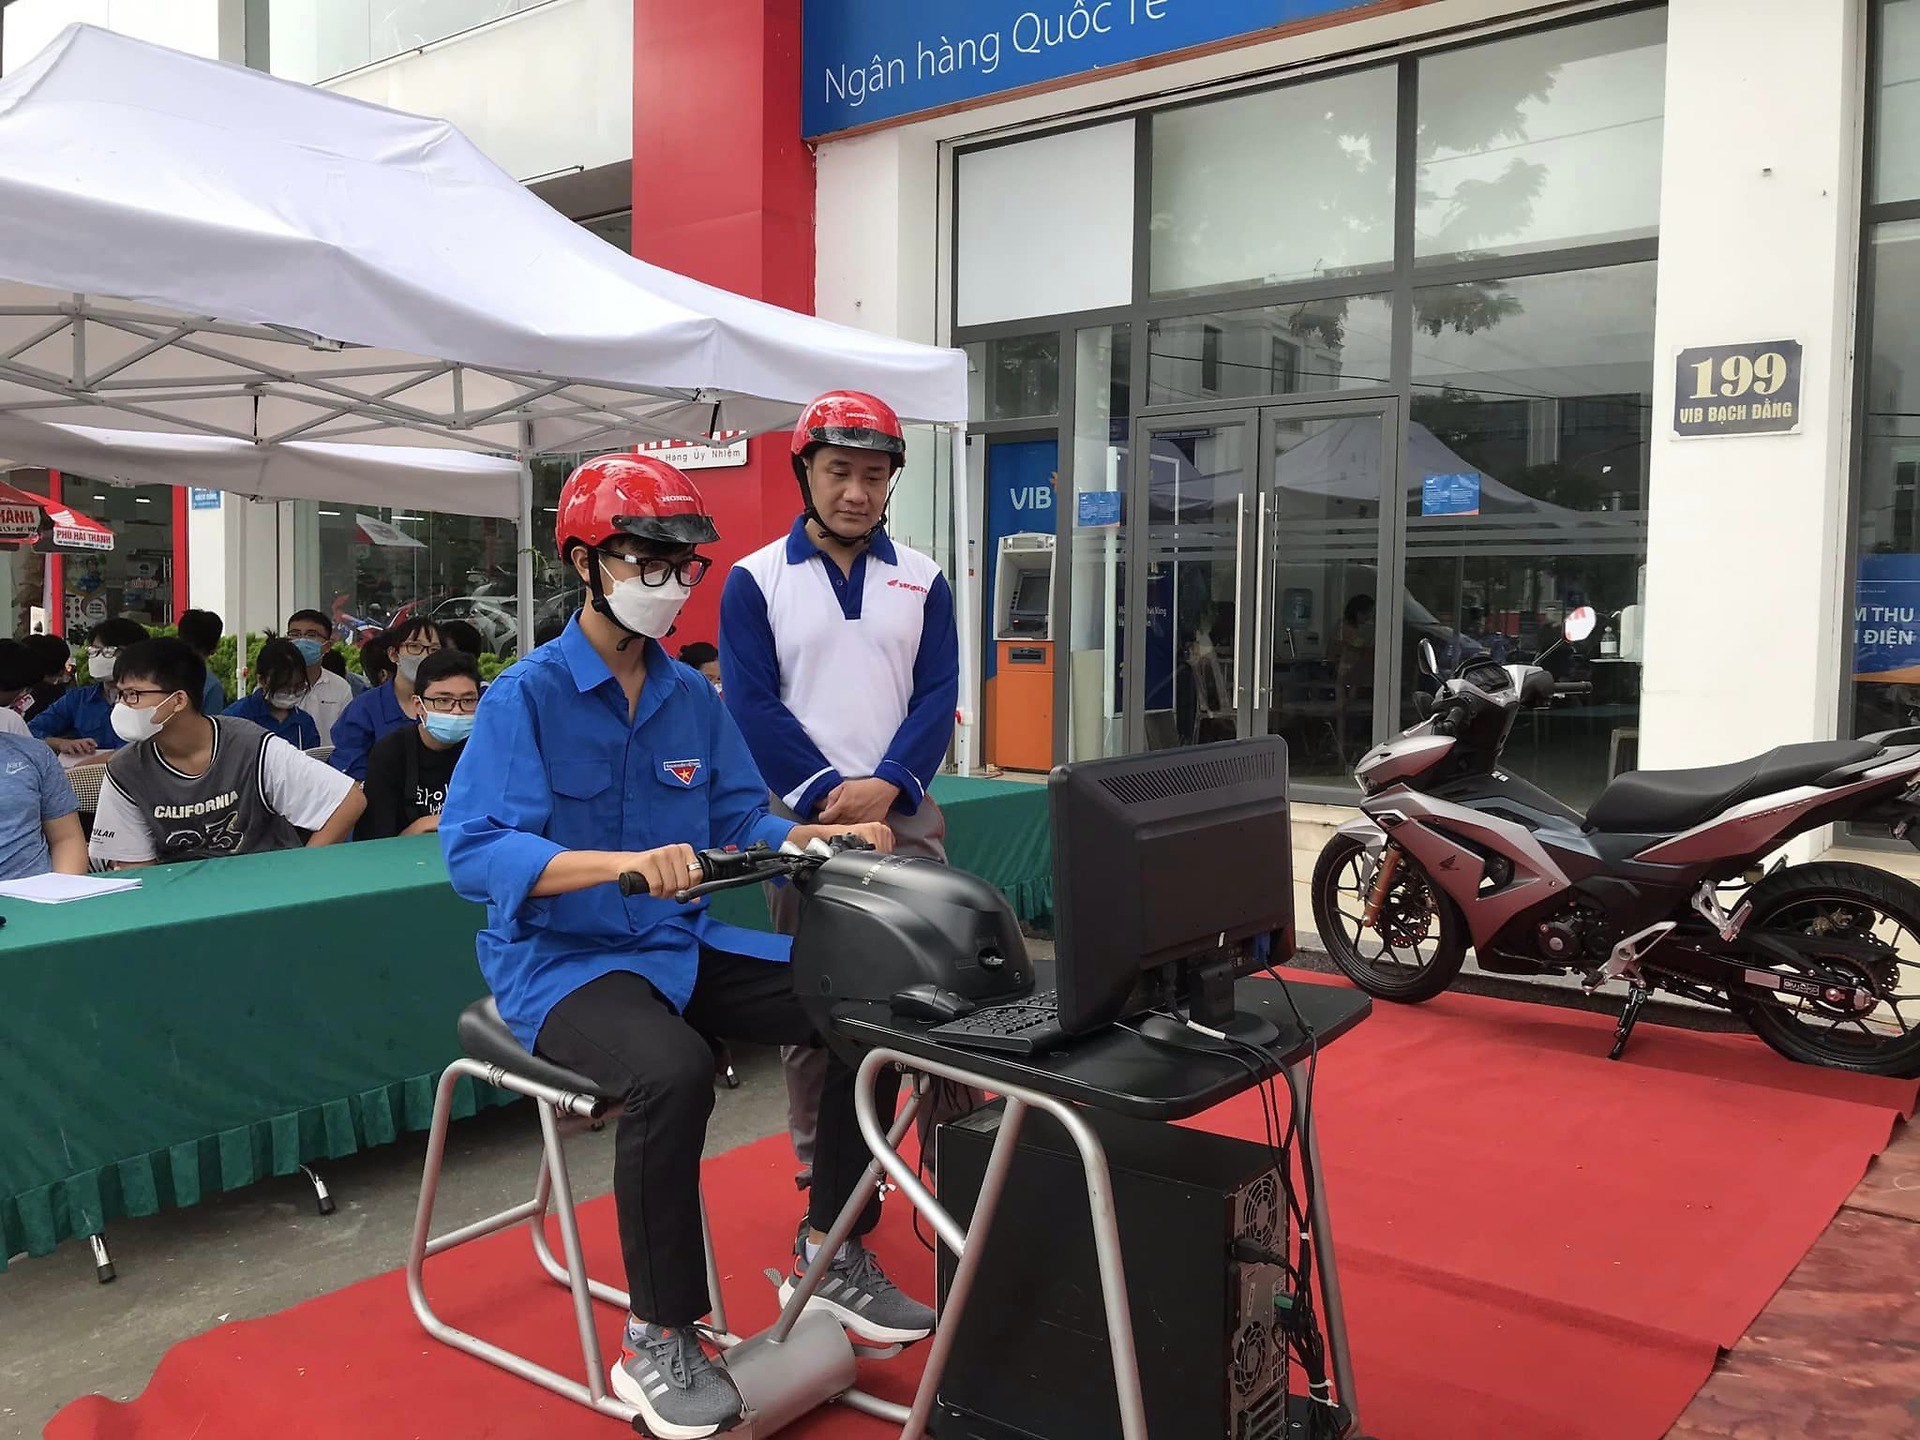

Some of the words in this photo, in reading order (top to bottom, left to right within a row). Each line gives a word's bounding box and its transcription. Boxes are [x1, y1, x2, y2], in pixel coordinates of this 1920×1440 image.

[825, 54, 905, 107] Ngân
[917, 31, 1000, 79] hàng
[1689, 352, 1787, 399] 199
[1680, 407, 1703, 424] VIB
[1708, 404, 1747, 425] BẠCH
[660, 494, 695, 502] HONDA
[1010, 486, 1052, 511] VIB
[1871, 607, 1915, 623] THU
[1863, 626, 1914, 648] ĐIỆN
[154, 790, 239, 819] CALIFORNIA
